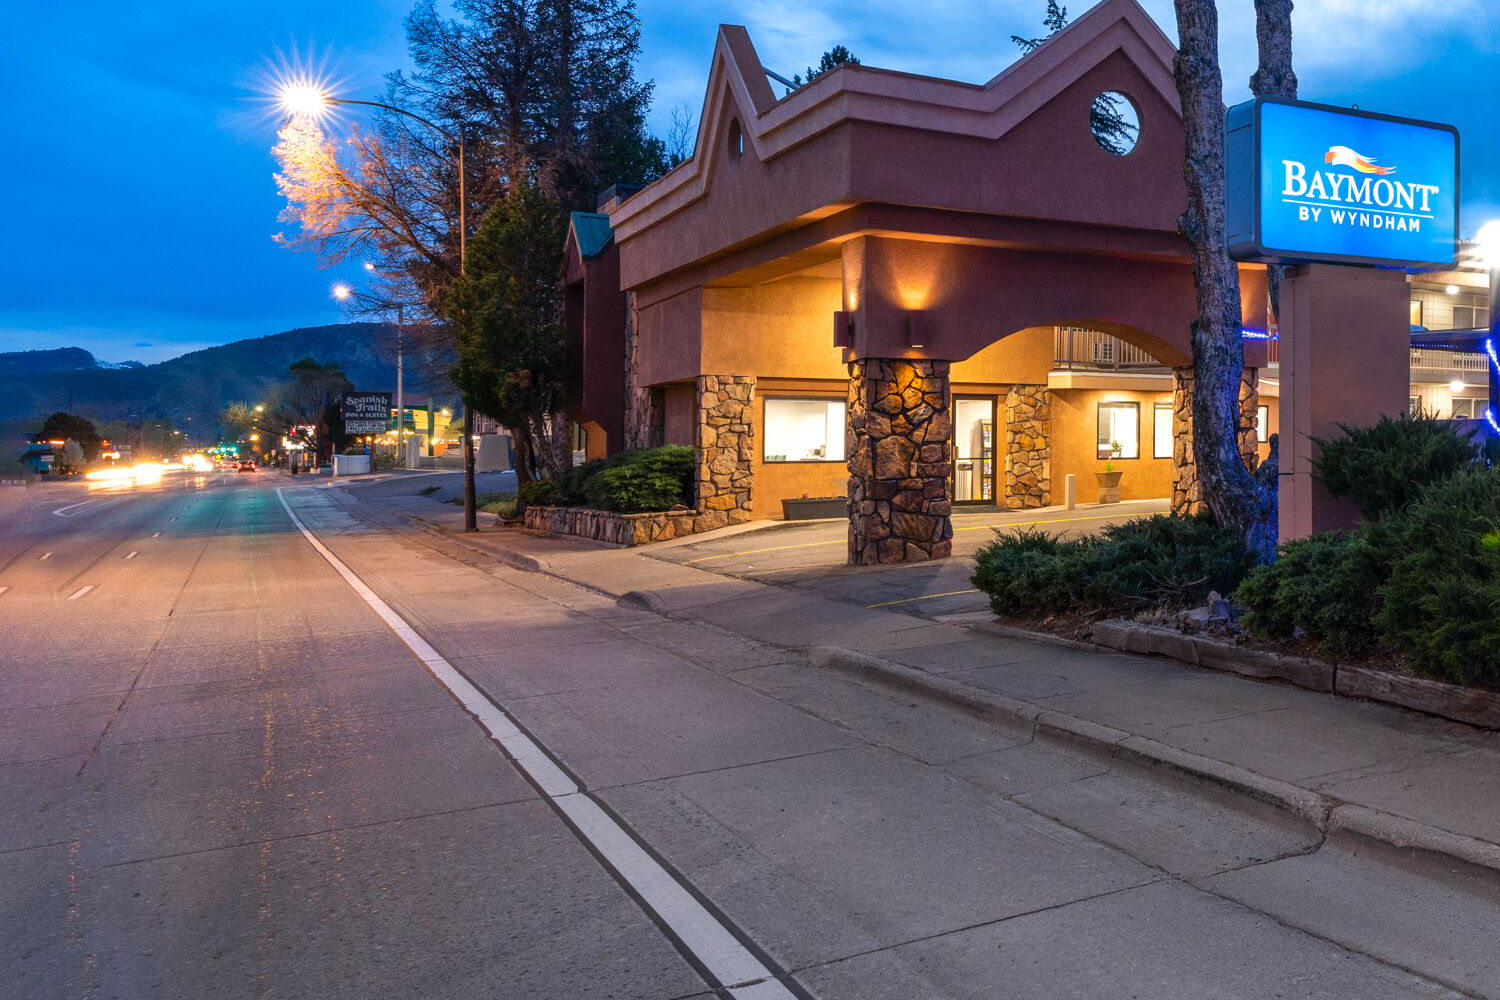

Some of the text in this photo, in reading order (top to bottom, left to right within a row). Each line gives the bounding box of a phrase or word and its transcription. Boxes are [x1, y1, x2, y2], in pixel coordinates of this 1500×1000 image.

[1281, 160, 1434, 212] BAYMONT
[1299, 206, 1420, 233] BY WYNDHAM
[346, 395, 388, 406] Spanish
[355, 403, 386, 412] Trails
